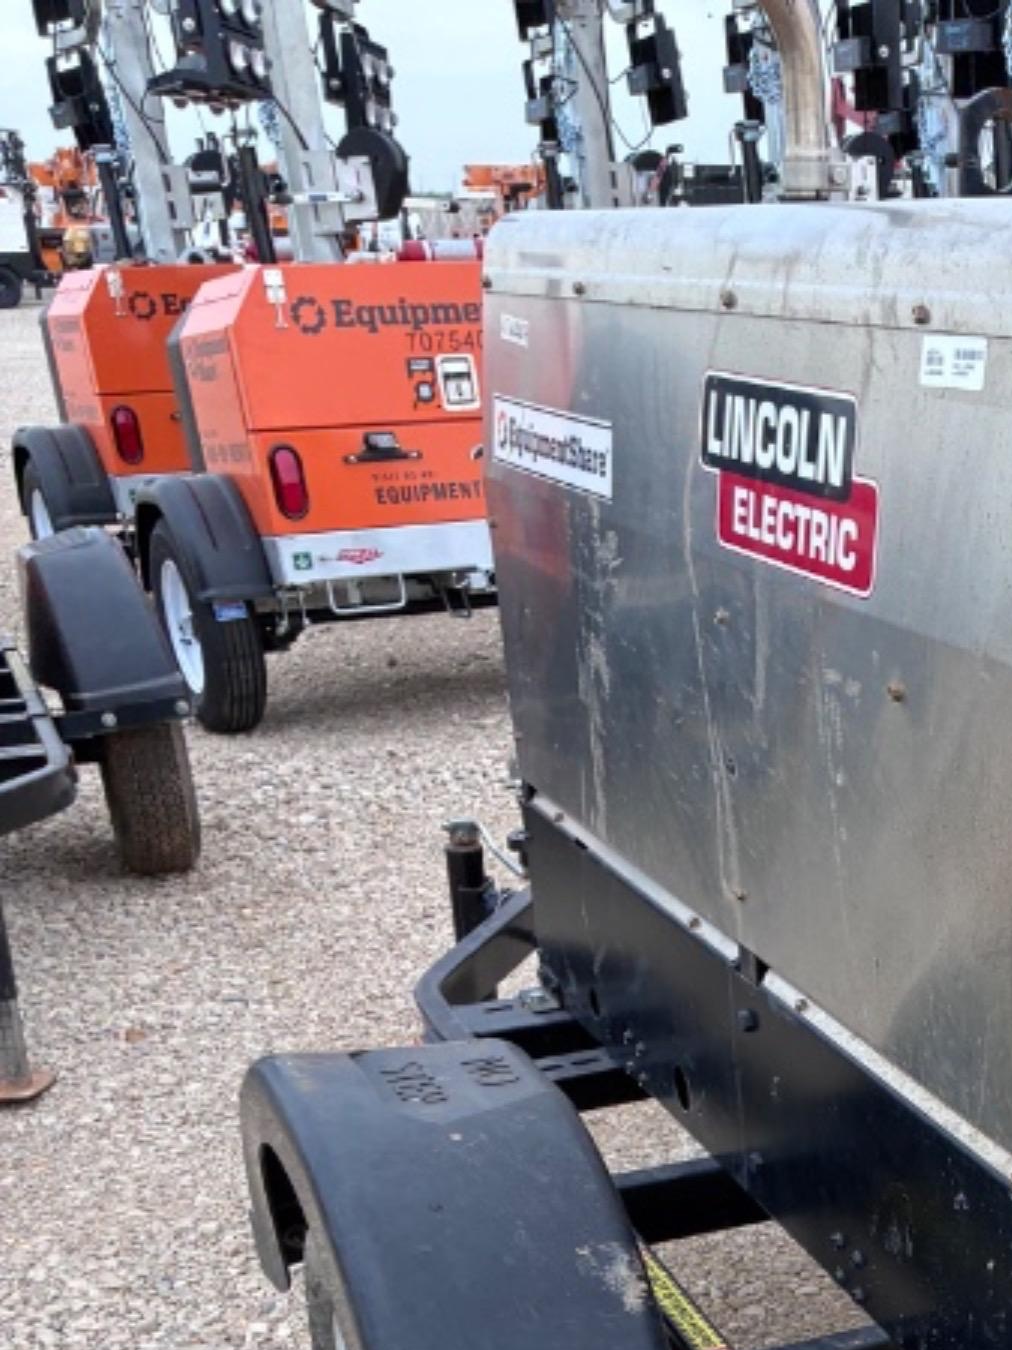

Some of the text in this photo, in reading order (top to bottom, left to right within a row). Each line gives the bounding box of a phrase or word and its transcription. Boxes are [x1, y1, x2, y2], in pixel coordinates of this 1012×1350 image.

[706, 389, 848, 487] LINCOLN
[376, 480, 482, 505] EQUIPMENT
[732, 485, 859, 572] ELECTRIC
